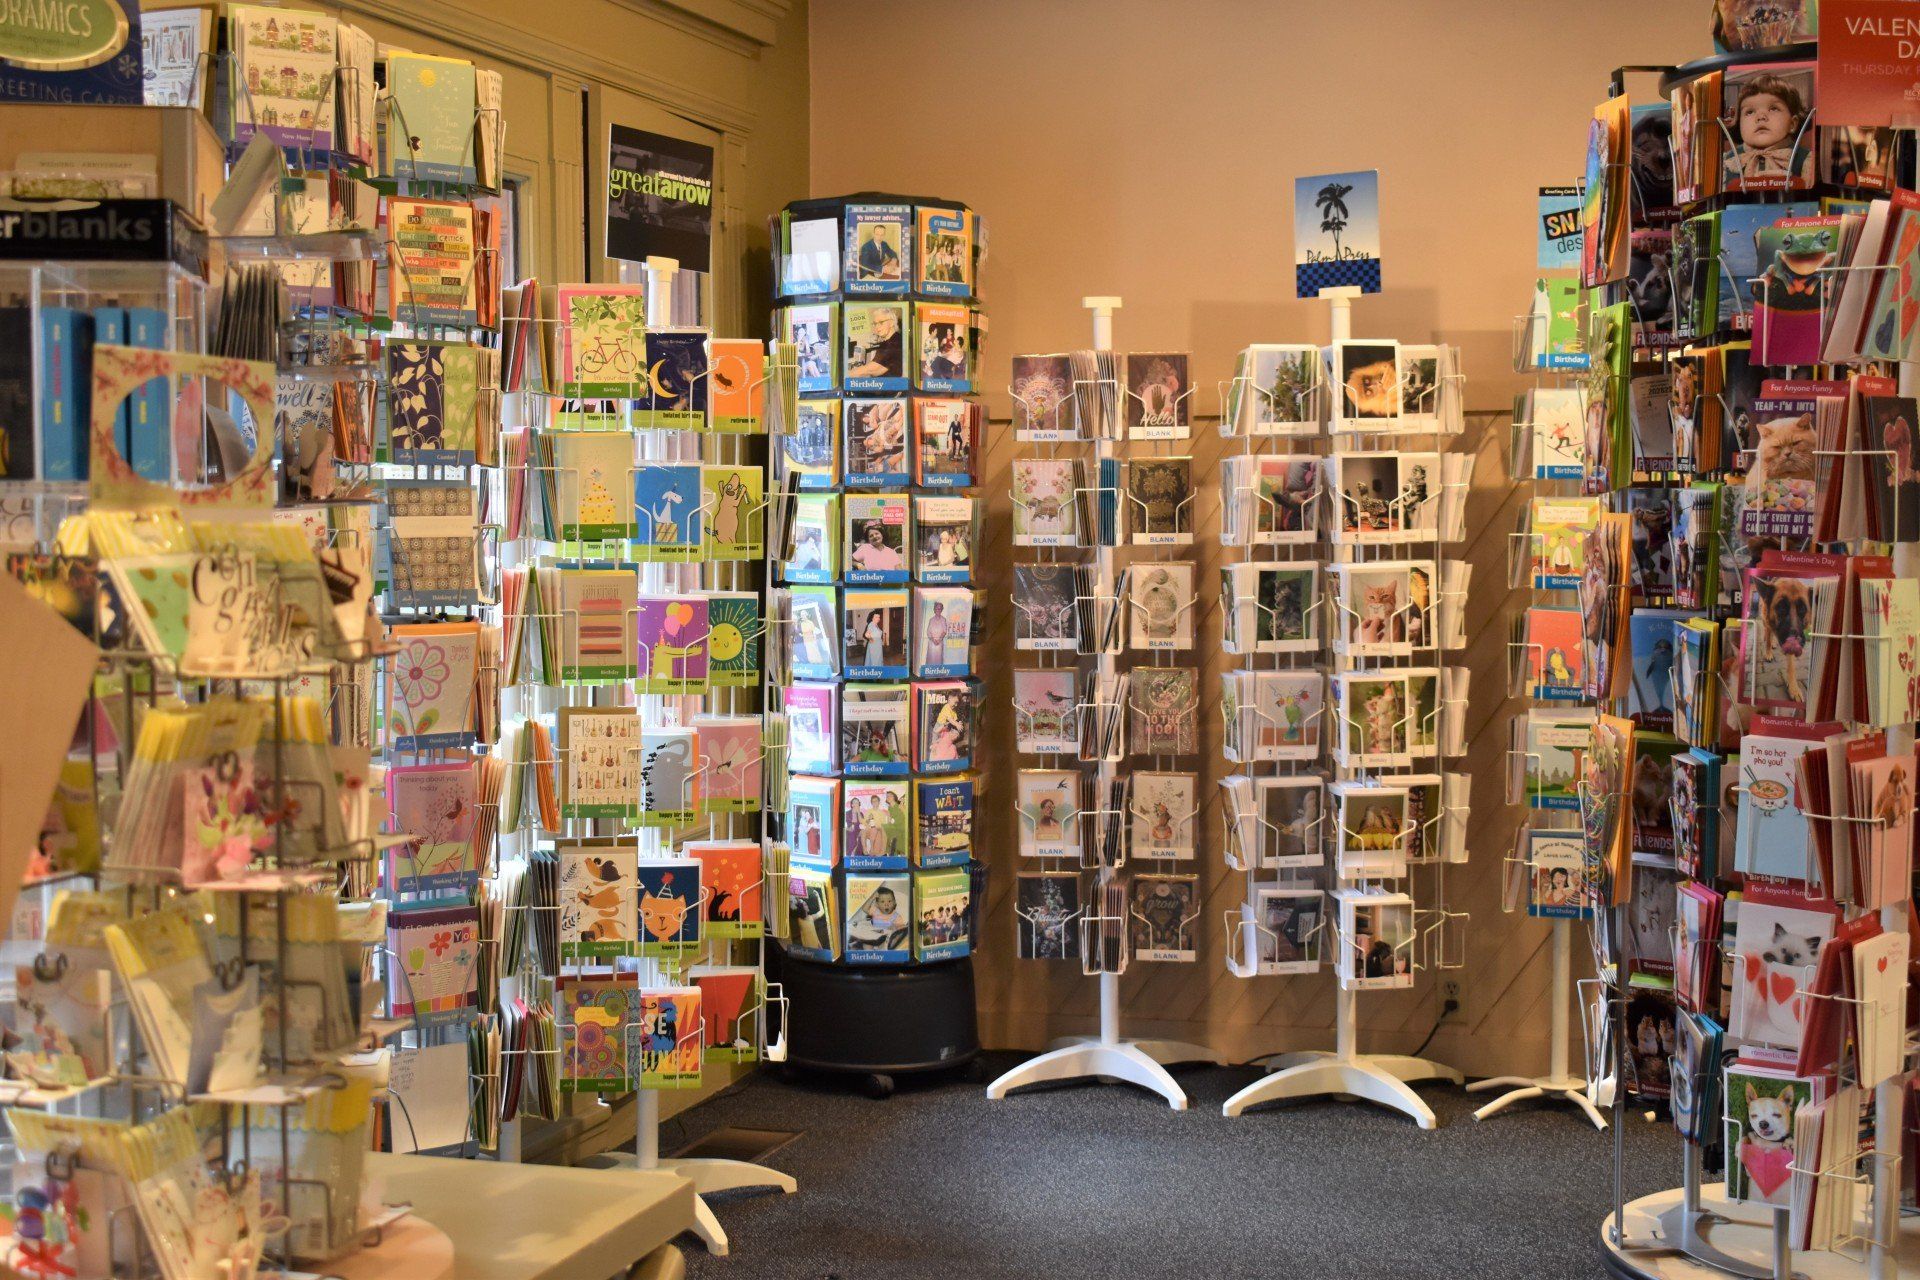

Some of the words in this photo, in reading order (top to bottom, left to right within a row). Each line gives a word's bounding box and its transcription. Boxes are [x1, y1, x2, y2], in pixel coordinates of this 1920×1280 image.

[1739, 180, 1767, 188] Almost
[1857, 175, 1882, 187] Birthday
[609, 168, 712, 207] greatarrow
[1795, 220, 1824, 228] Anyone
[1306, 249, 1334, 264] Palm
[1343, 246, 1371, 261] Press
[850, 283, 884, 292] Birthday
[926, 285, 952, 293] Birthday
[1554, 356, 1586, 364] Birthday
[850, 381, 884, 390] Birthday
[927, 382, 953, 391] Birthday
[1785, 384, 1812, 392] Anyone
[1812, 384, 1833, 393] Funny
[276, 384, 315, 408] well
[1796, 401, 1815, 411] INTO
[1140, 411, 1174, 426] Hello
[1554, 467, 1584, 475] Birthday
[1771, 513, 1791, 522] EVERY
[1793, 514, 1805, 522] BIT
[1772, 524, 1789, 533] INTO
[1792, 525, 1804, 534] MY
[1781, 554, 1820, 564] Valentine's
[1821, 558, 1836, 566] Day
[796, 572, 820, 581] Birthday
[851, 573, 884, 582] Birthday
[926, 574, 952, 582] Birthday
[850, 669, 883, 678] Birthday
[925, 668, 951, 676] Birthday
[1551, 688, 1581, 697] Birthday
[1761, 717, 1793, 727] Romantic
[1794, 720, 1816, 729] Funny
[1751, 746, 1763, 754] I'm
[1774, 749, 1787, 757] hot
[1754, 757, 1766, 766] pho
[1768, 758, 1783, 767] you!
[851, 766, 883, 774] Birthday
[926, 764, 951, 772] Birthday
[400, 775, 424, 784] Thinking
[944, 787, 960, 795] can't
[935, 795, 964, 808] WAIT
[1548, 799, 1579, 807] Birthday
[850, 859, 883, 868] Birthday
[926, 857, 952, 867] Birthday
[1764, 887, 1790, 897] Anyone
[1546, 907, 1577, 916] Birthday
[453, 932, 475, 943] You
[851, 953, 884, 961] Birthday
[926, 951, 952, 960] Birthday
[1644, 961, 1674, 970] Romance
[1751, 1050, 1782, 1060] romantic
[1641, 1085, 1670, 1094] Romance
